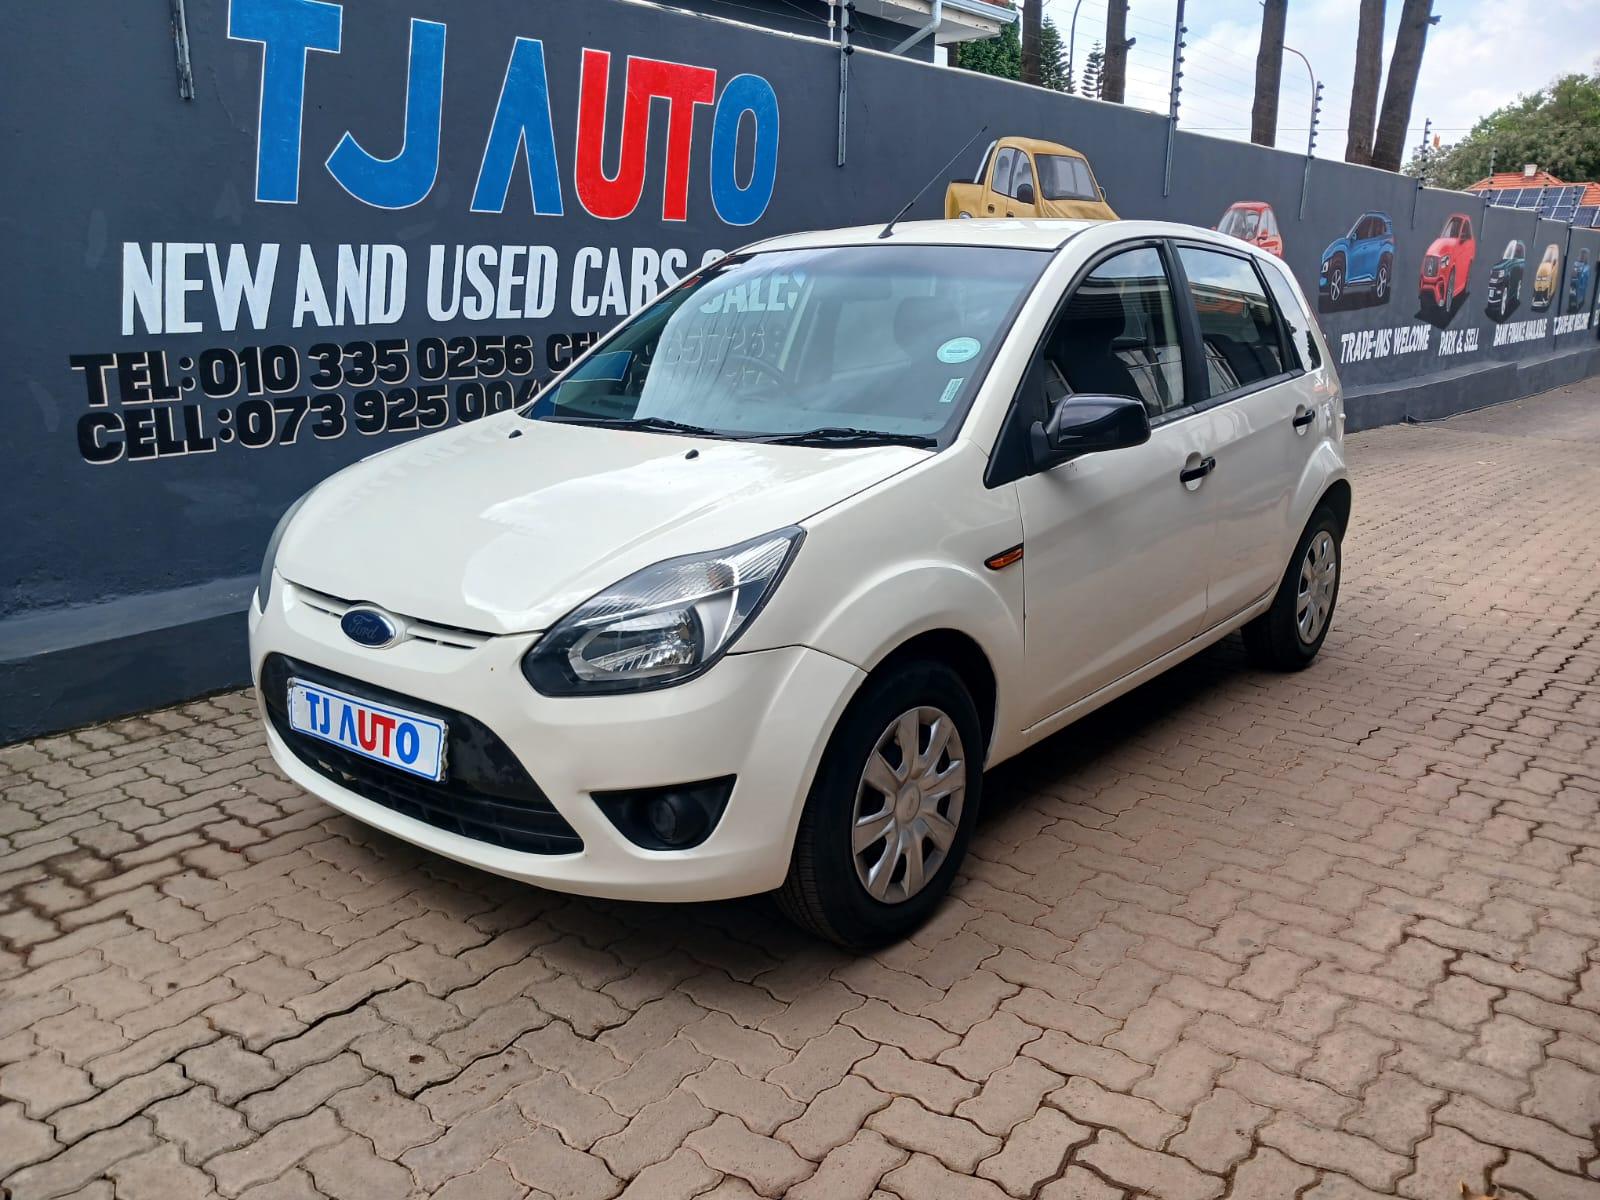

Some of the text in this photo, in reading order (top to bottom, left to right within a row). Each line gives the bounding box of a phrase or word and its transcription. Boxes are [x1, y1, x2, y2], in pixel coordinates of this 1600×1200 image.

[226, 0, 780, 226] TJ AUTO
[121, 242, 280, 336] NEW
[293, 244, 407, 328] AND
[427, 245, 558, 322] USED
[570, 246, 688, 317] CARS
[70, 344, 300, 404] TEL:010
[309, 339, 410, 390] 335
[417, 335, 534, 382] 0256
[1340, 324, 1431, 363] TRADE-INS WELCOME
[1438, 330, 1457, 356] PARK
[1463, 327, 1479, 352] SELL
[77, 393, 347, 465] CELL:073
[353, 384, 449, 436] 925
[348, 614, 380, 641] Ford
[306, 693, 420, 764] TJ AUTO
